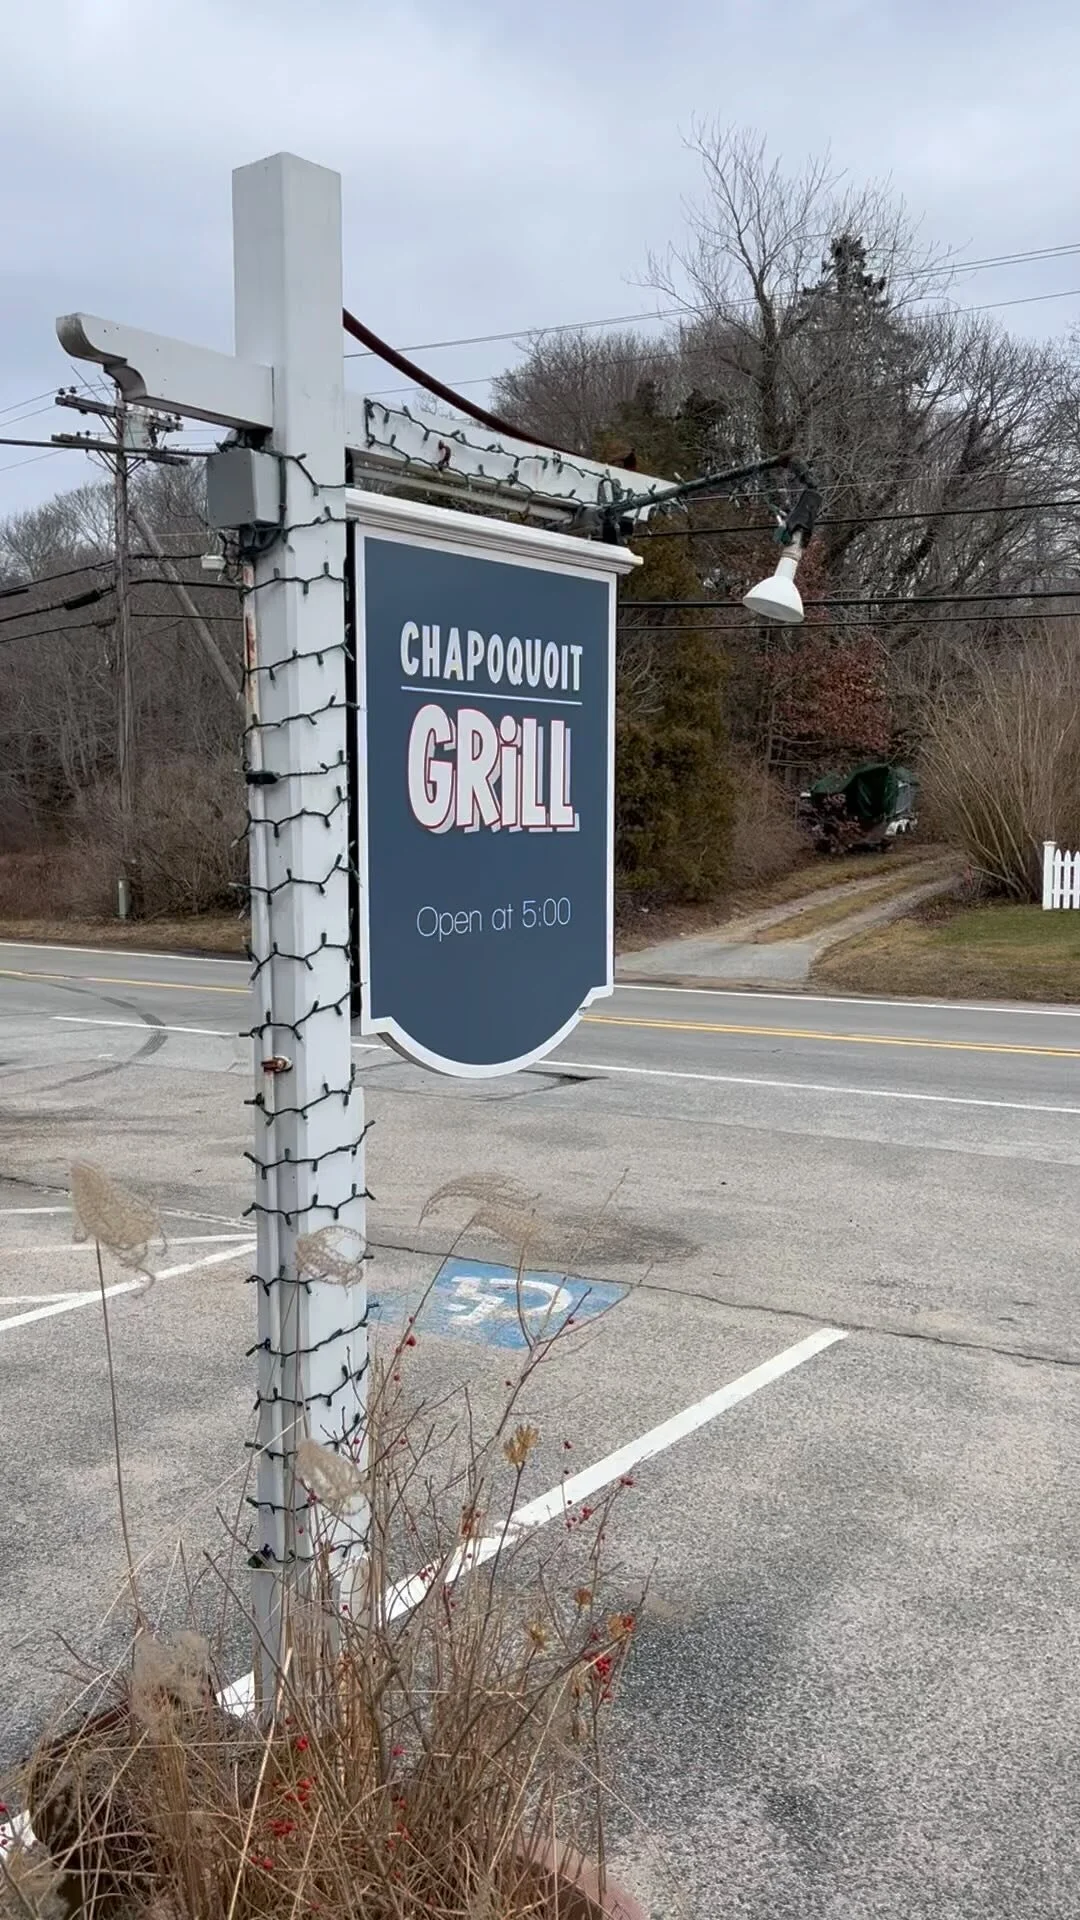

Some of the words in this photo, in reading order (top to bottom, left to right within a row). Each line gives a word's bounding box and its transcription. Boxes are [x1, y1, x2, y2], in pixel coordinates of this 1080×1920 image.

[400, 620, 584, 692] CHAPOQUOIT
[416, 905, 483, 942] Open
[492, 902, 513, 931] at
[521, 896, 571, 929] 5:00
